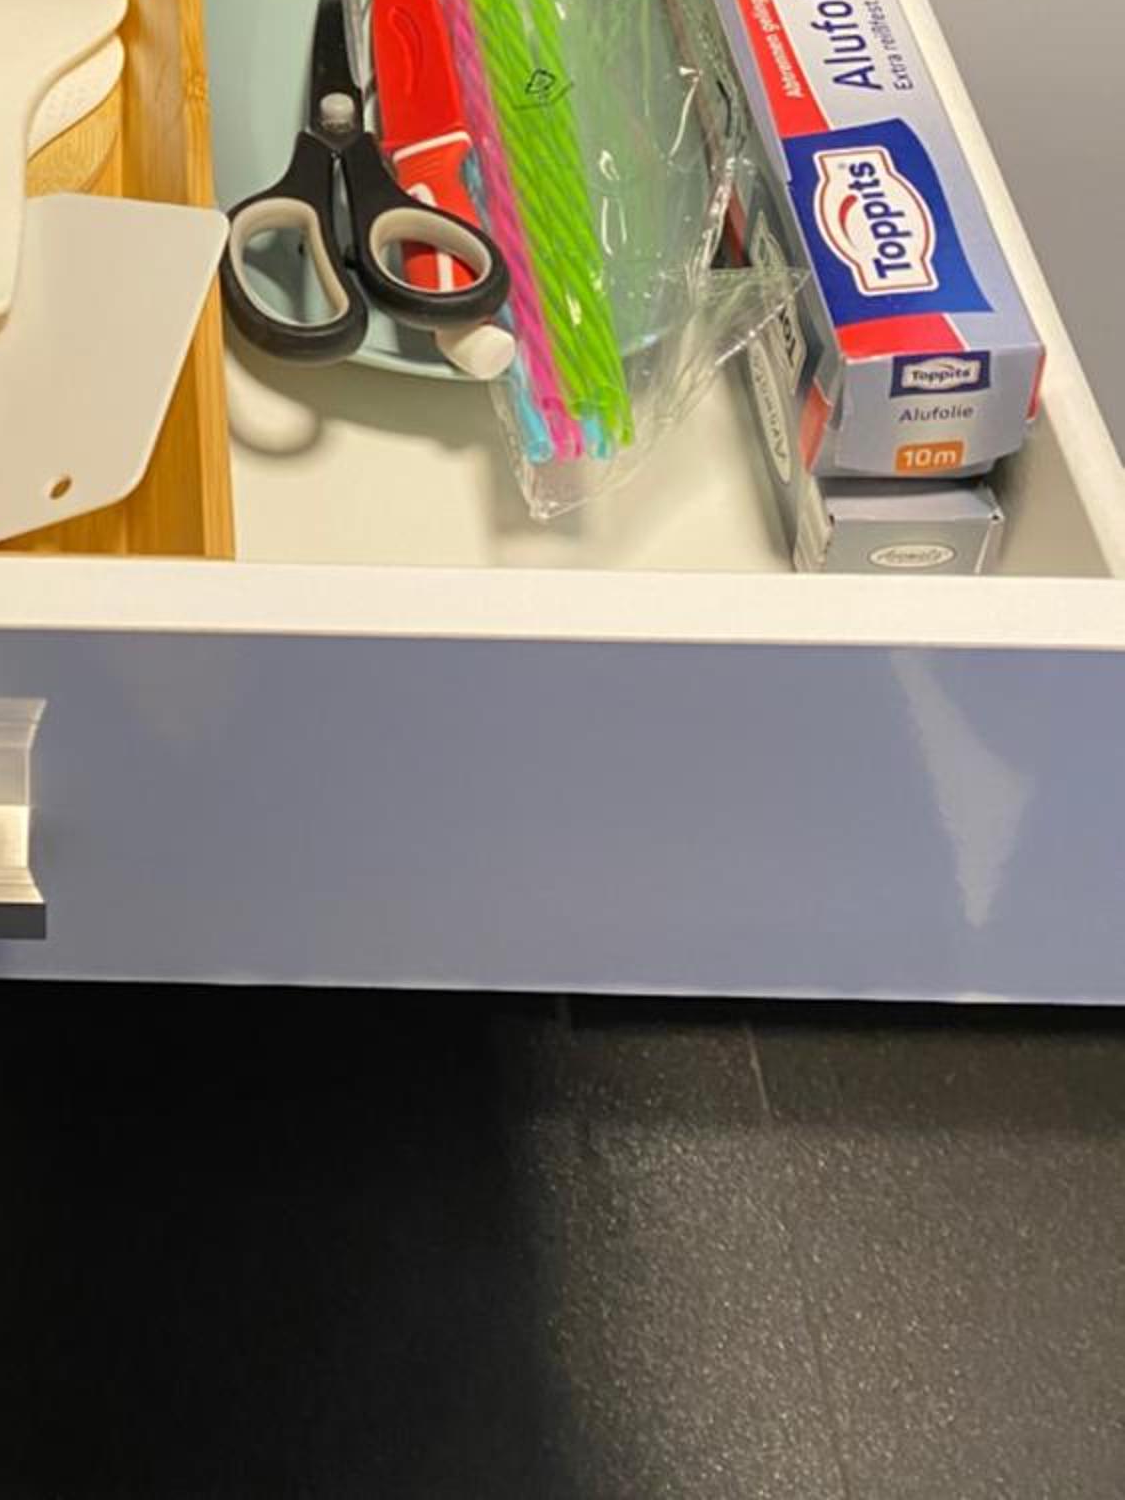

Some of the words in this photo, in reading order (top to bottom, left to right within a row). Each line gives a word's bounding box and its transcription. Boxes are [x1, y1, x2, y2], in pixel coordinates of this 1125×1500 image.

[864, 0, 898, 51] reißfest
[888, 53, 914, 91] Extra
[847, 161, 913, 279] Toppits
[911, 366, 972, 383] Toppits
[898, 404, 974, 424] Alufolie
[903, 449, 957, 469] 10m
